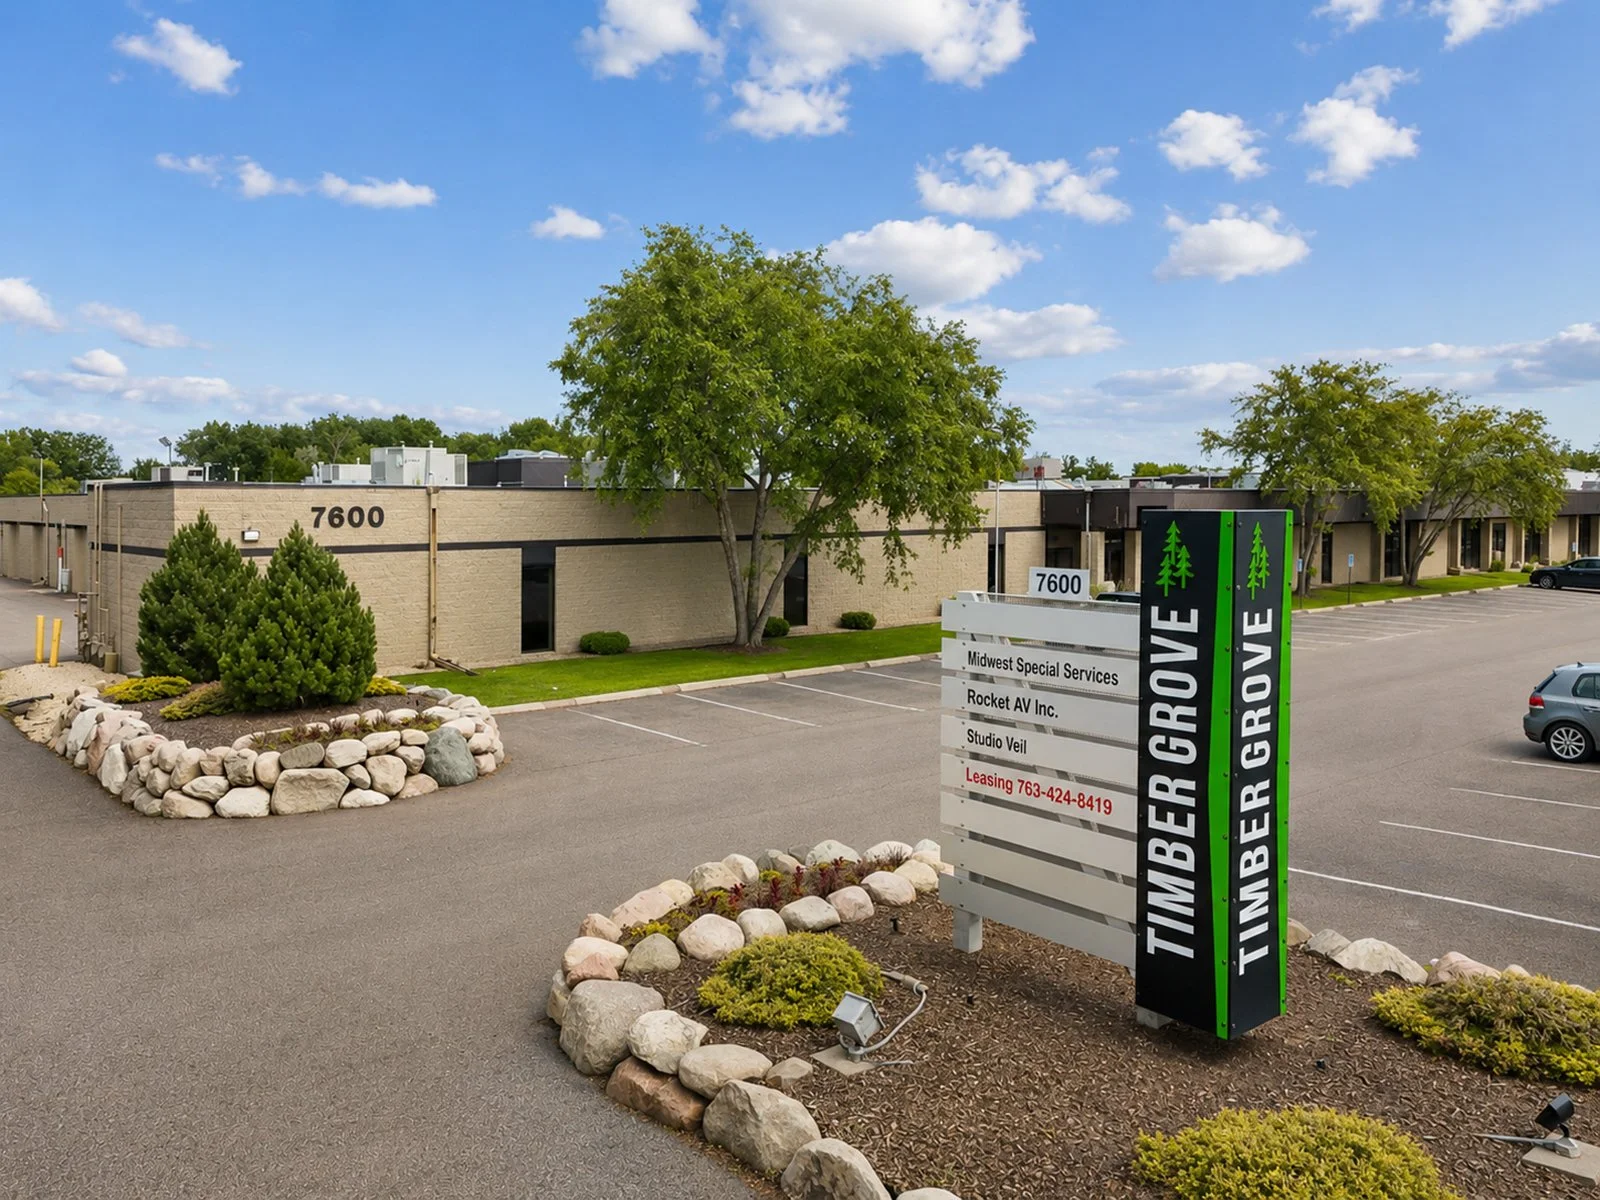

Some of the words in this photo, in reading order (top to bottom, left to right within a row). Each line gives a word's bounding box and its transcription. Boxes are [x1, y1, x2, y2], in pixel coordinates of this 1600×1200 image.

[311, 505, 385, 529] 7600
[1036, 573, 1082, 595] 7600
[967, 650, 1014, 672] Midwest
[1016, 658, 1060, 679] Special
[1063, 665, 1119, 687] Services
[1148, 606, 1199, 766] GROVE
[1240, 608, 1273, 771] GROVE
[967, 689, 1010, 711] Rocket
[1013, 698, 1031, 715] AV
[1034, 700, 1059, 719] Inc.
[967, 728, 1003, 750] Studio
[1005, 736, 1027, 755] Veil
[965, 767, 1014, 796] Leasing
[1017, 778, 1113, 816] 763-424-8419
[1146, 774, 1197, 958] TIMBER
[1238, 778, 1272, 976] TIMBER
